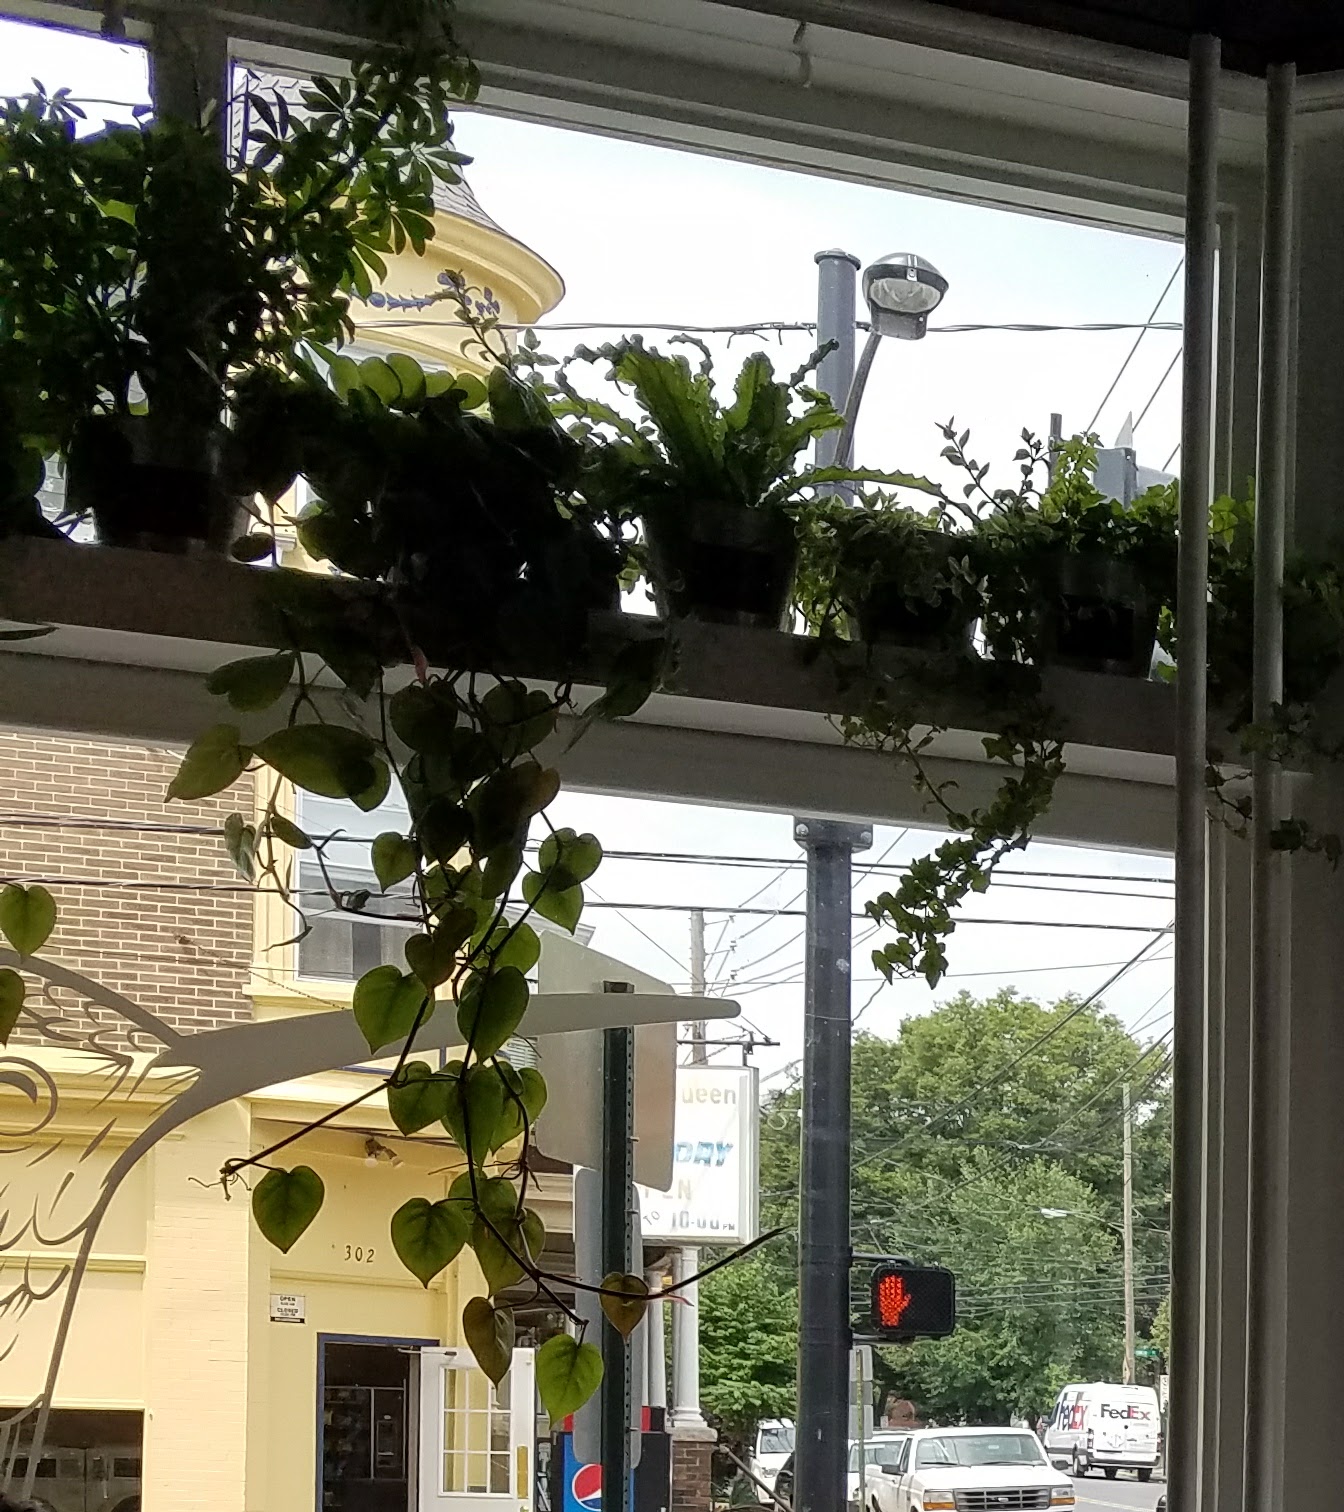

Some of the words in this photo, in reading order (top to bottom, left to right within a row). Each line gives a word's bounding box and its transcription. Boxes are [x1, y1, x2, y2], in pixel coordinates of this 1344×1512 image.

[681, 1085, 738, 1105] ueen
[344, 1244, 375, 1264] 302
[1100, 1403, 1151, 1421] FedEx
